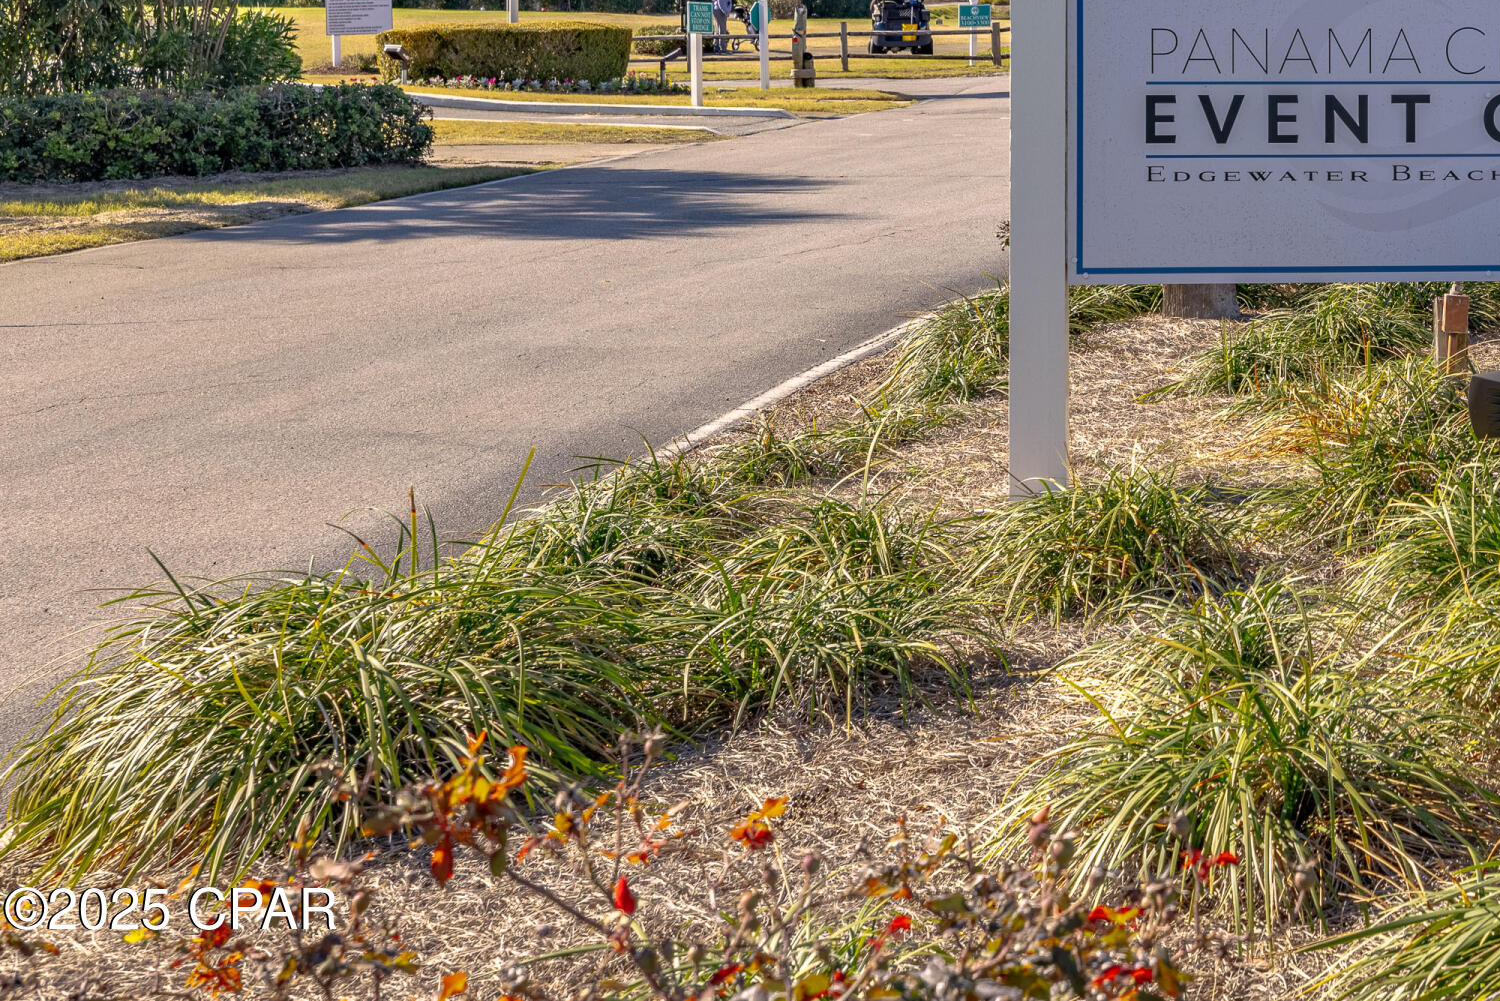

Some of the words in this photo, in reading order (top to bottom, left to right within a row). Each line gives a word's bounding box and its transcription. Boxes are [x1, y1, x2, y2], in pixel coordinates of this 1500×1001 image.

[1150, 26, 1423, 75] PANAMA
[1144, 93, 1431, 144] EVENT
[1146, 164, 1369, 183] EDGEWATER
